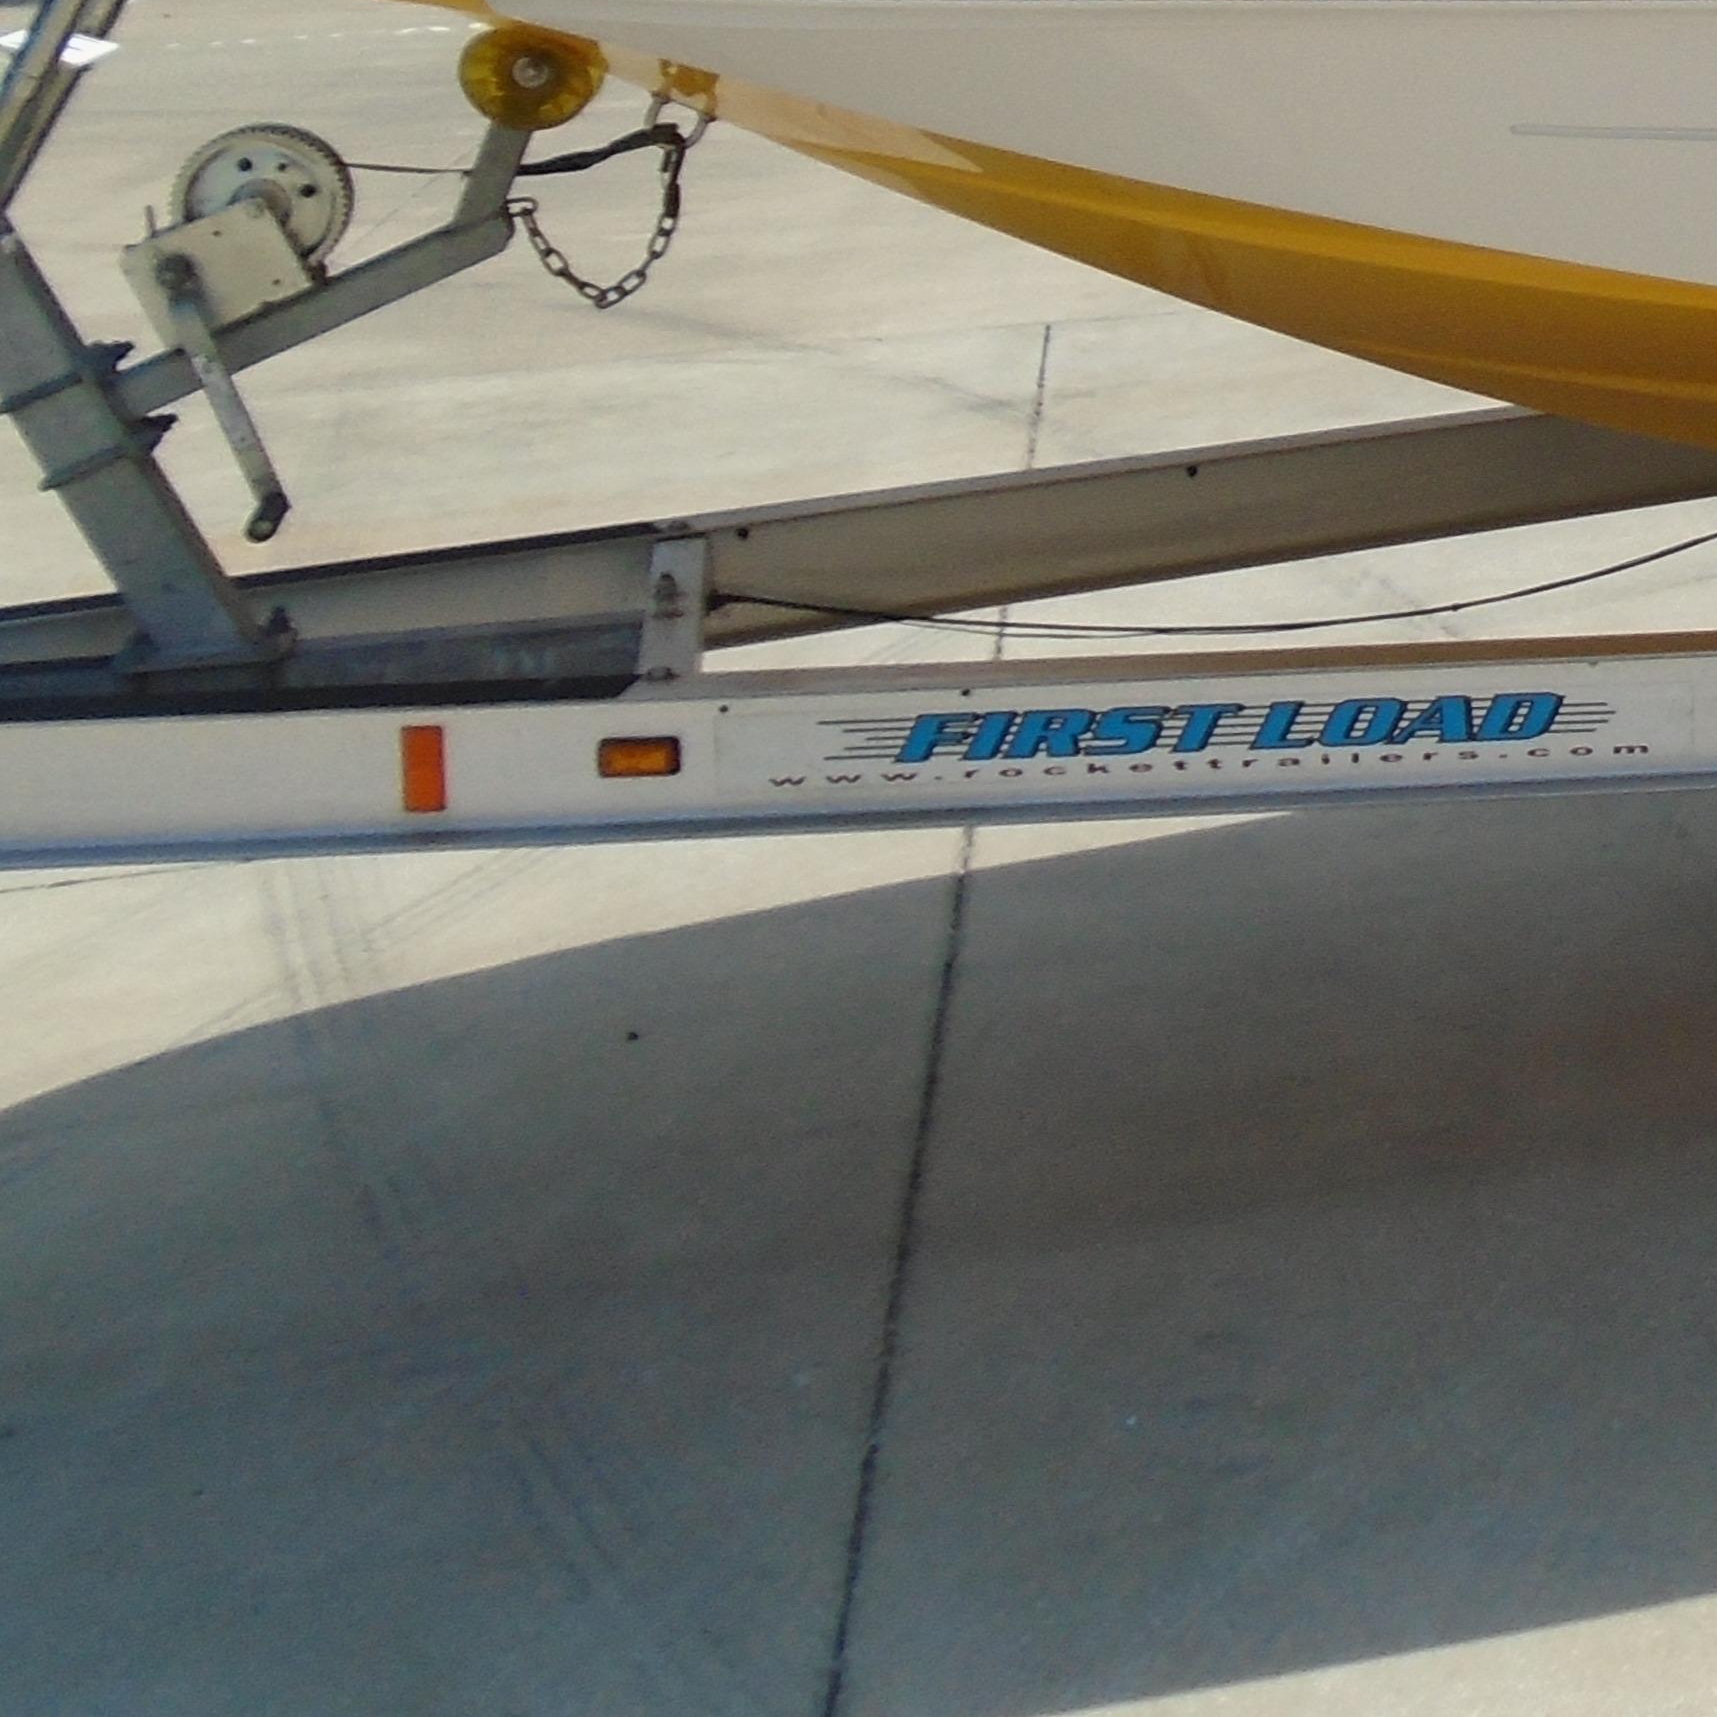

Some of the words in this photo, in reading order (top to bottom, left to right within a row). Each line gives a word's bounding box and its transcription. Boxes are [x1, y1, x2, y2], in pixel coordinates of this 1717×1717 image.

[894, 703, 1245, 764] FIRST
[1249, 691, 1566, 751] LOAD
[769, 743, 1650, 787] www.rockettrailers.com
